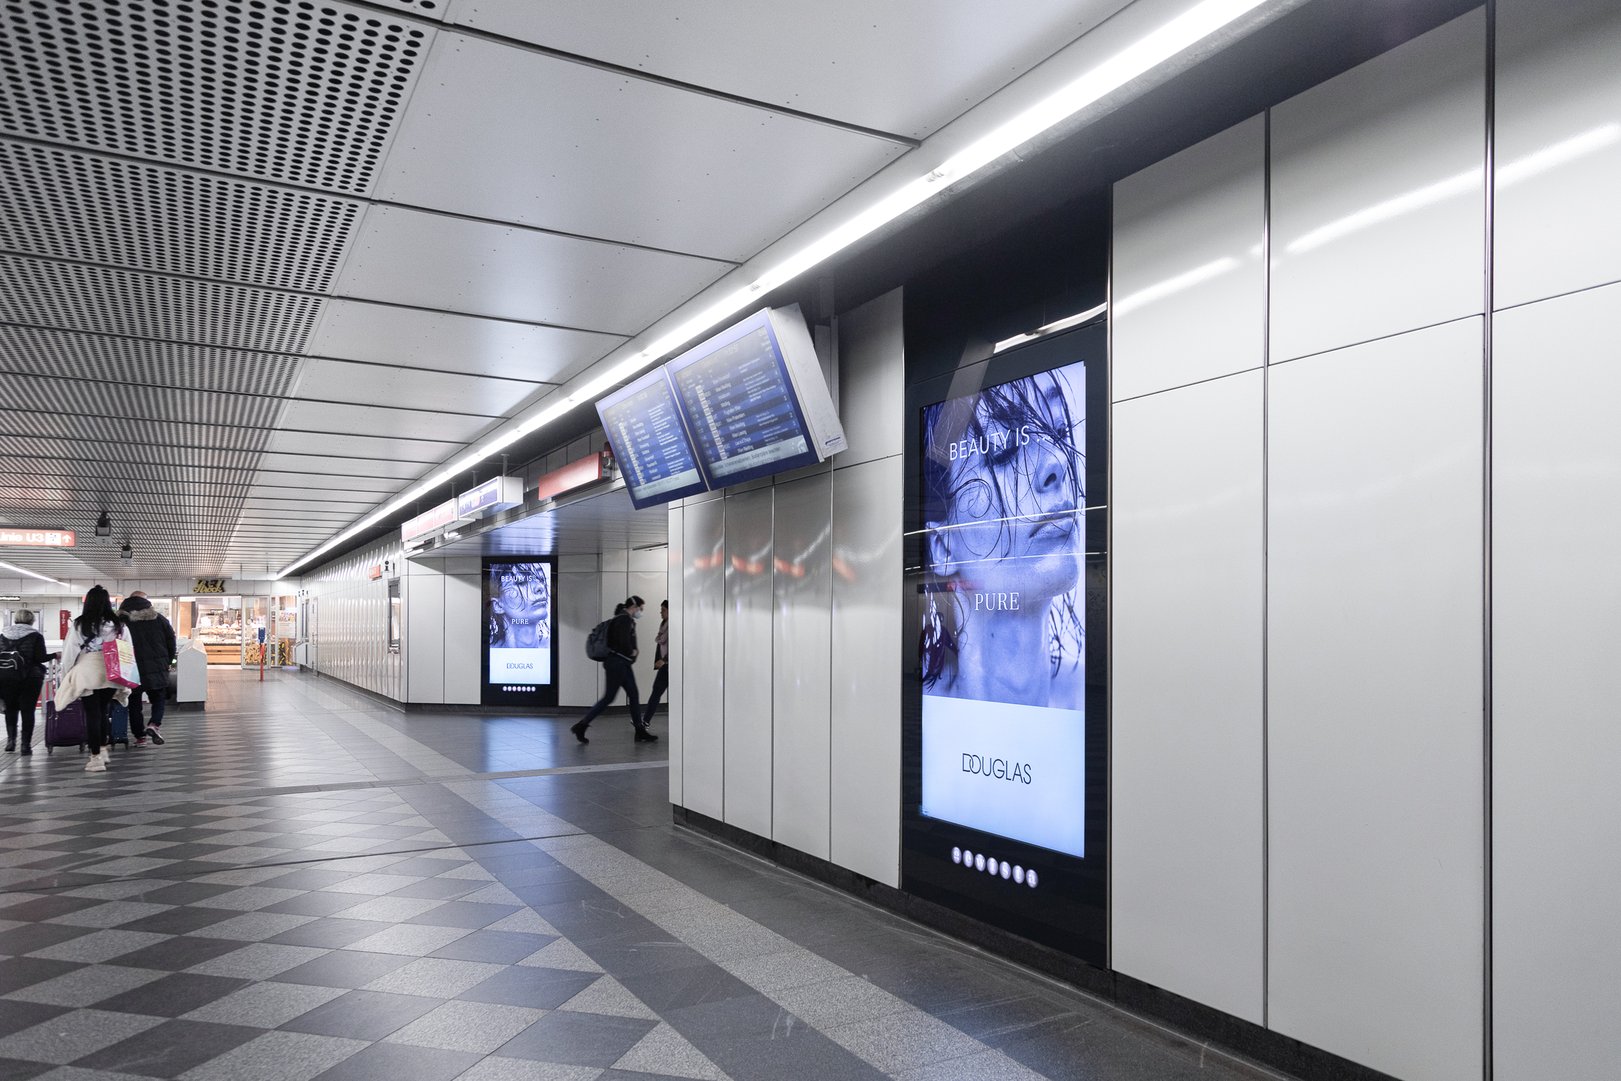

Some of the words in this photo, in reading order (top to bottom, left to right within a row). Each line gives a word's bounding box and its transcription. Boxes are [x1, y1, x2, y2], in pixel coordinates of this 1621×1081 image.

[949, 429, 1011, 461] BEAUTY
[1016, 425, 1030, 447] IS
[974, 591, 1020, 611] PURE
[506, 662, 534, 670] DOUGLAS
[962, 752, 1032, 785] DOUGLAS
